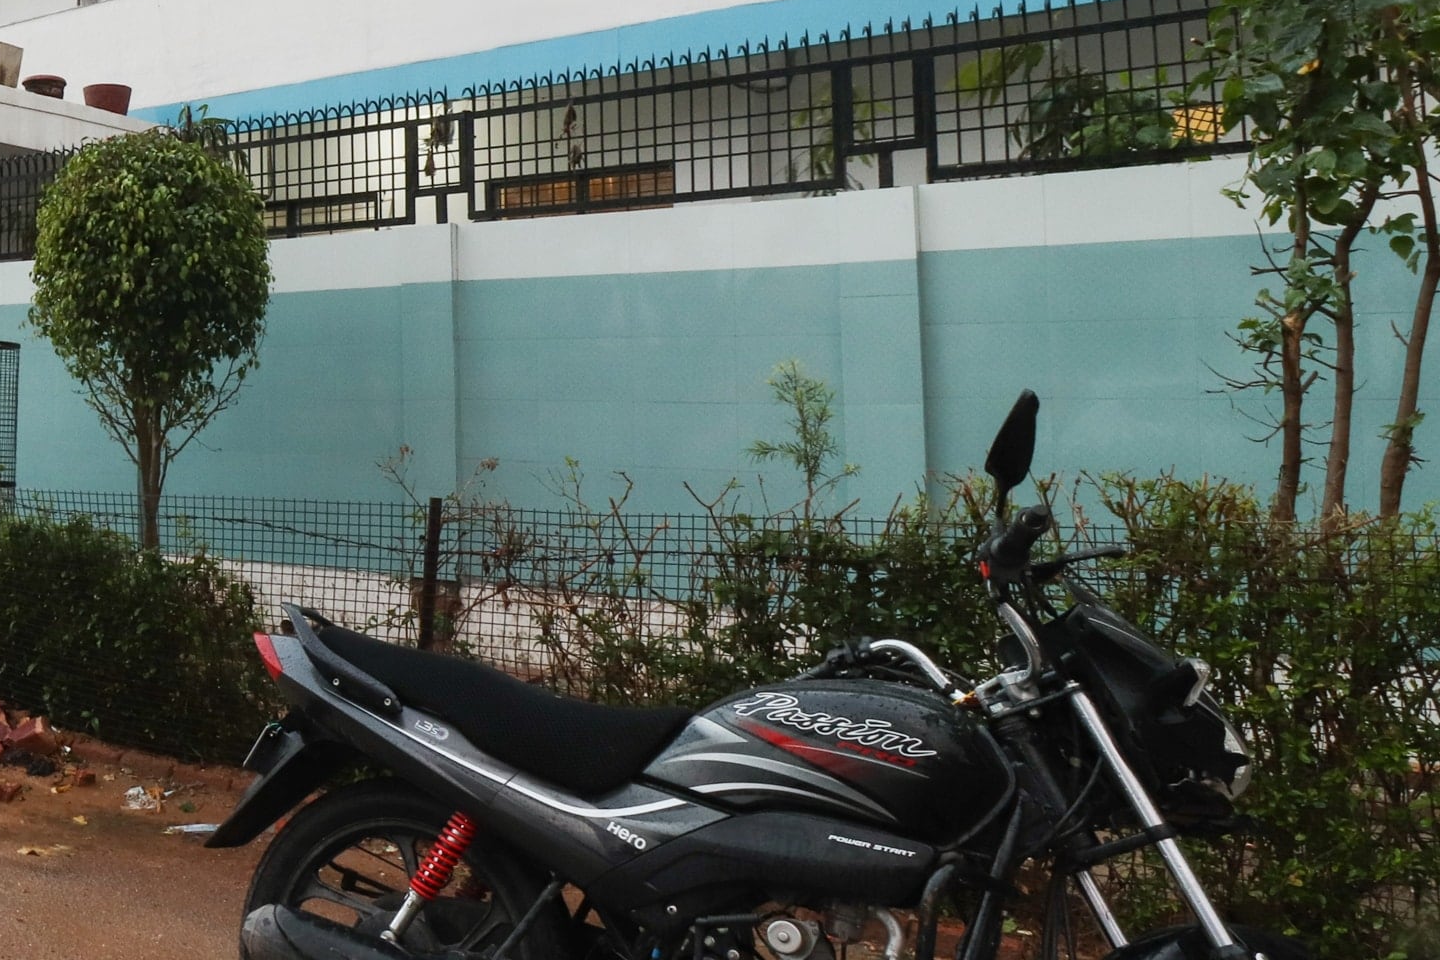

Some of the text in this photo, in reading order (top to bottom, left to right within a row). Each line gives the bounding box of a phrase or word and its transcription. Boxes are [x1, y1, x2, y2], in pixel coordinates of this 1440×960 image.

[733, 692, 938, 757] Passion
[606, 821, 647, 850] Hero
[827, 834, 917, 857] POWER START
